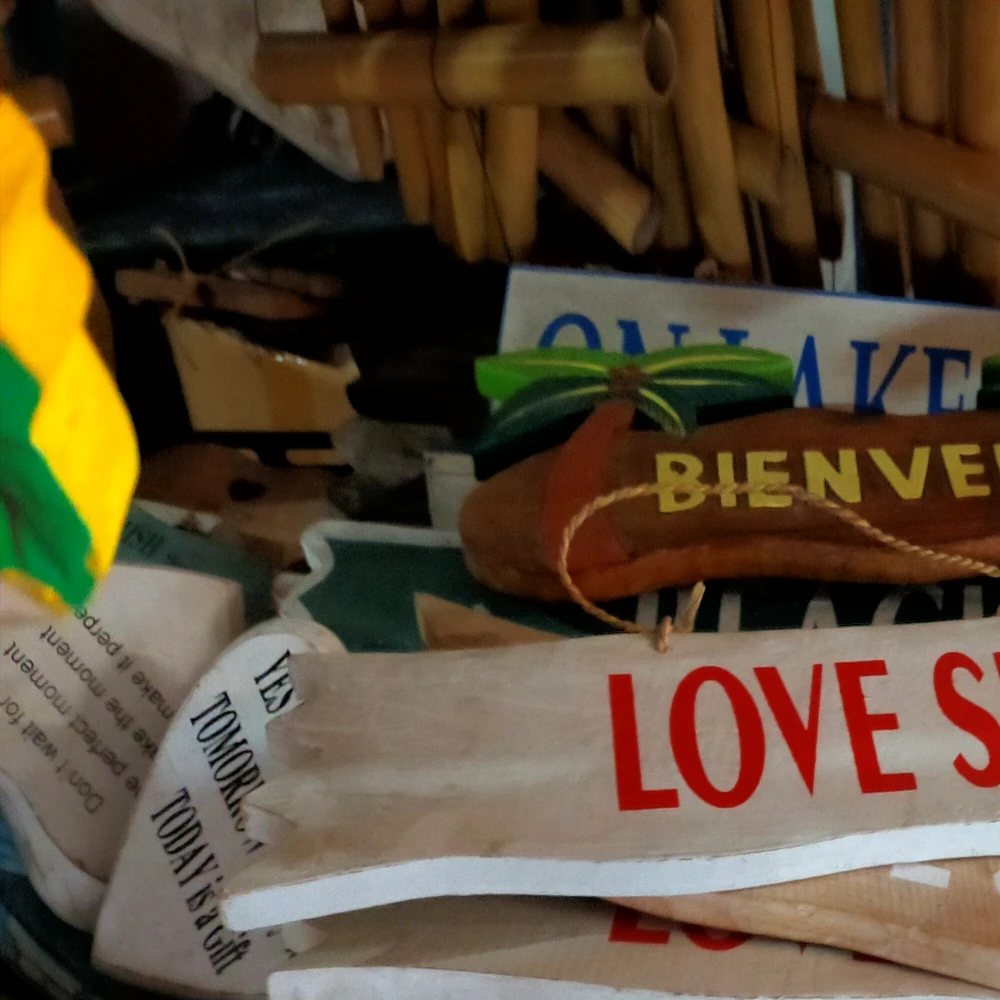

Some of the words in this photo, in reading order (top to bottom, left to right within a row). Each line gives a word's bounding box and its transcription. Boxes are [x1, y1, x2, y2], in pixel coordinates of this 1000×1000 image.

[3, 641, 71, 715] moment
[39, 625, 107, 697] moment
[105, 698, 134, 731] the
[132, 671, 176, 720] make
[21, 721, 58, 759] wait
[69, 714, 128, 776] perfect
[609, 660, 916, 811] LOVE
[190, 690, 266, 854] TOMOR
[151, 787, 220, 887] TODAY
[185, 875, 223, 912] is
